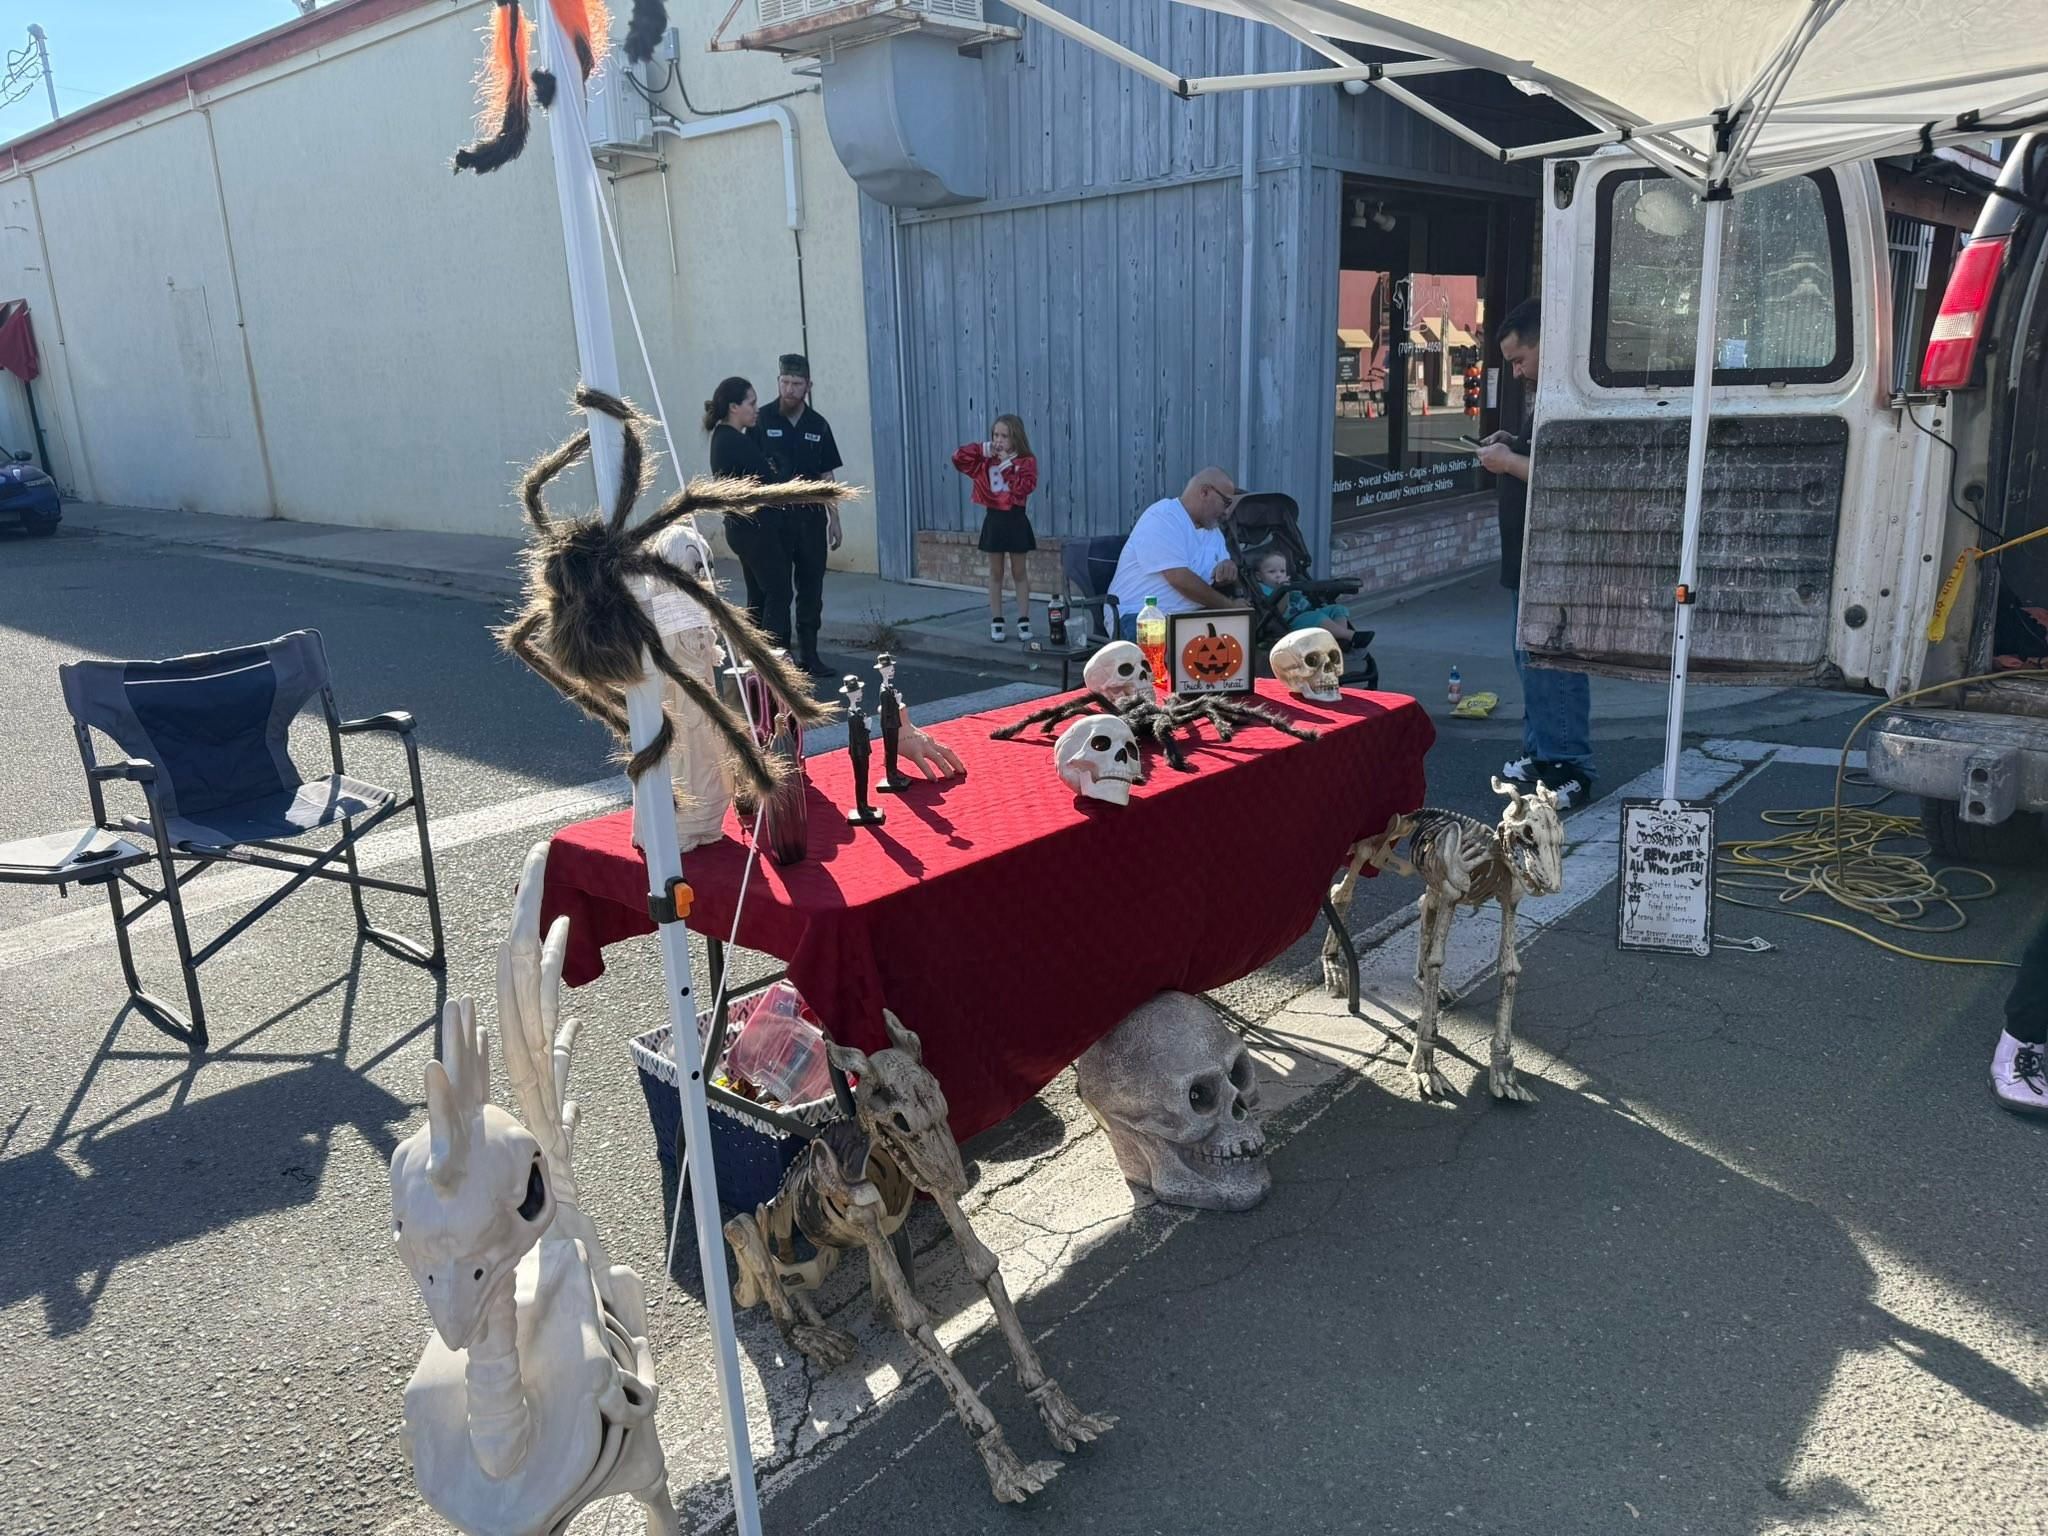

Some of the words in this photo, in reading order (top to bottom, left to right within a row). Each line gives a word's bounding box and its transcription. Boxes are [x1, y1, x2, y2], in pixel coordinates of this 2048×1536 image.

[1358, 474, 1381, 488] Sweat
[1382, 469, 1404, 484] Shirts
[1409, 466, 1427, 480] Caps
[1432, 461, 1448, 475] Polo
[1448, 458, 1467, 472] Shirts
[1356, 492, 1375, 506] Lake
[1376, 488, 1402, 503] County
[1402, 480, 1434, 497] Souvenir
[1434, 478, 1454, 491] Shirts
[1180, 679, 1203, 691] Trick
[1663, 825, 1677, 834] THE
[1686, 833, 1701, 846] INN
[1643, 847, 1693, 864] BEWARE
[1629, 858, 1645, 873] ALL
[1671, 862, 1704, 876] ENTER!
